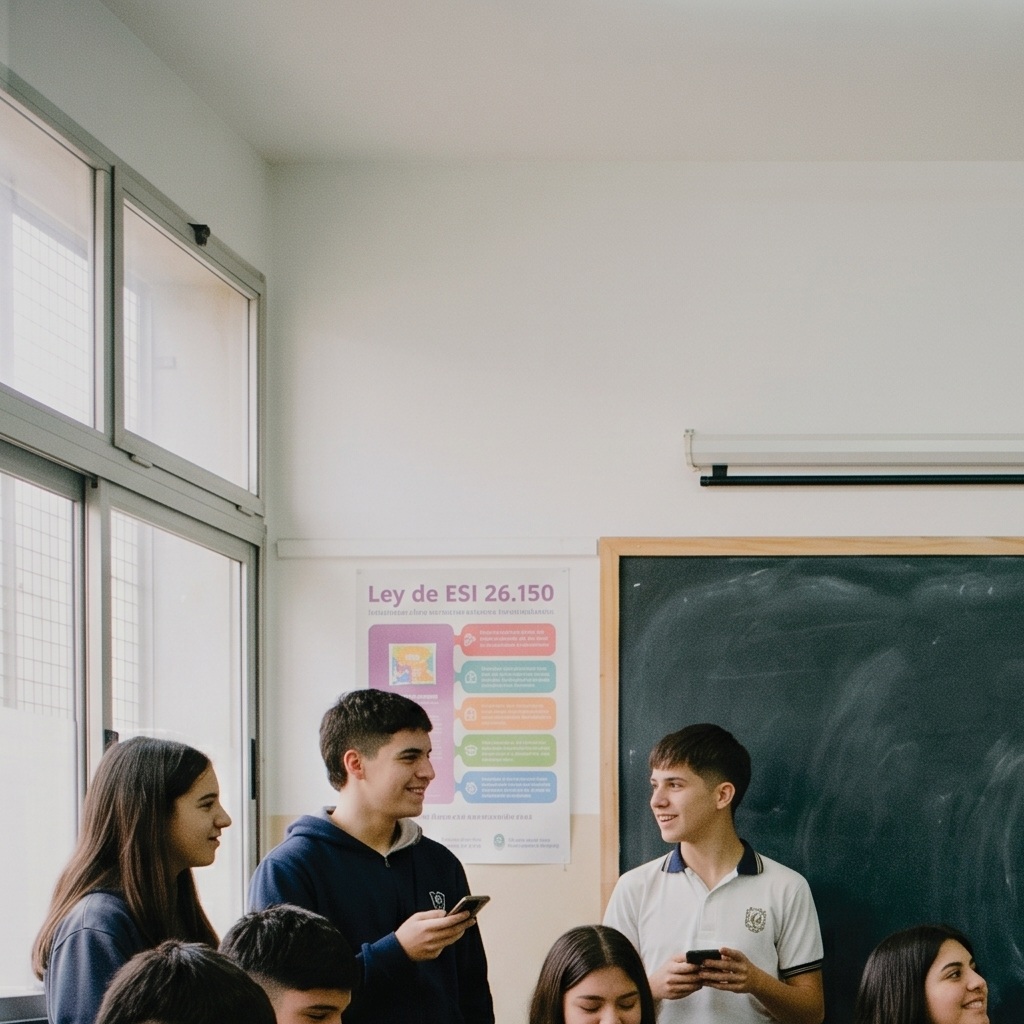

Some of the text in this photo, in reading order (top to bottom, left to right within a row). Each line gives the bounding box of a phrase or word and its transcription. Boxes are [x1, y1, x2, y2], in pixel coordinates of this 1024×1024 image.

[368, 584, 555, 608] Ley de ESI 26.150
